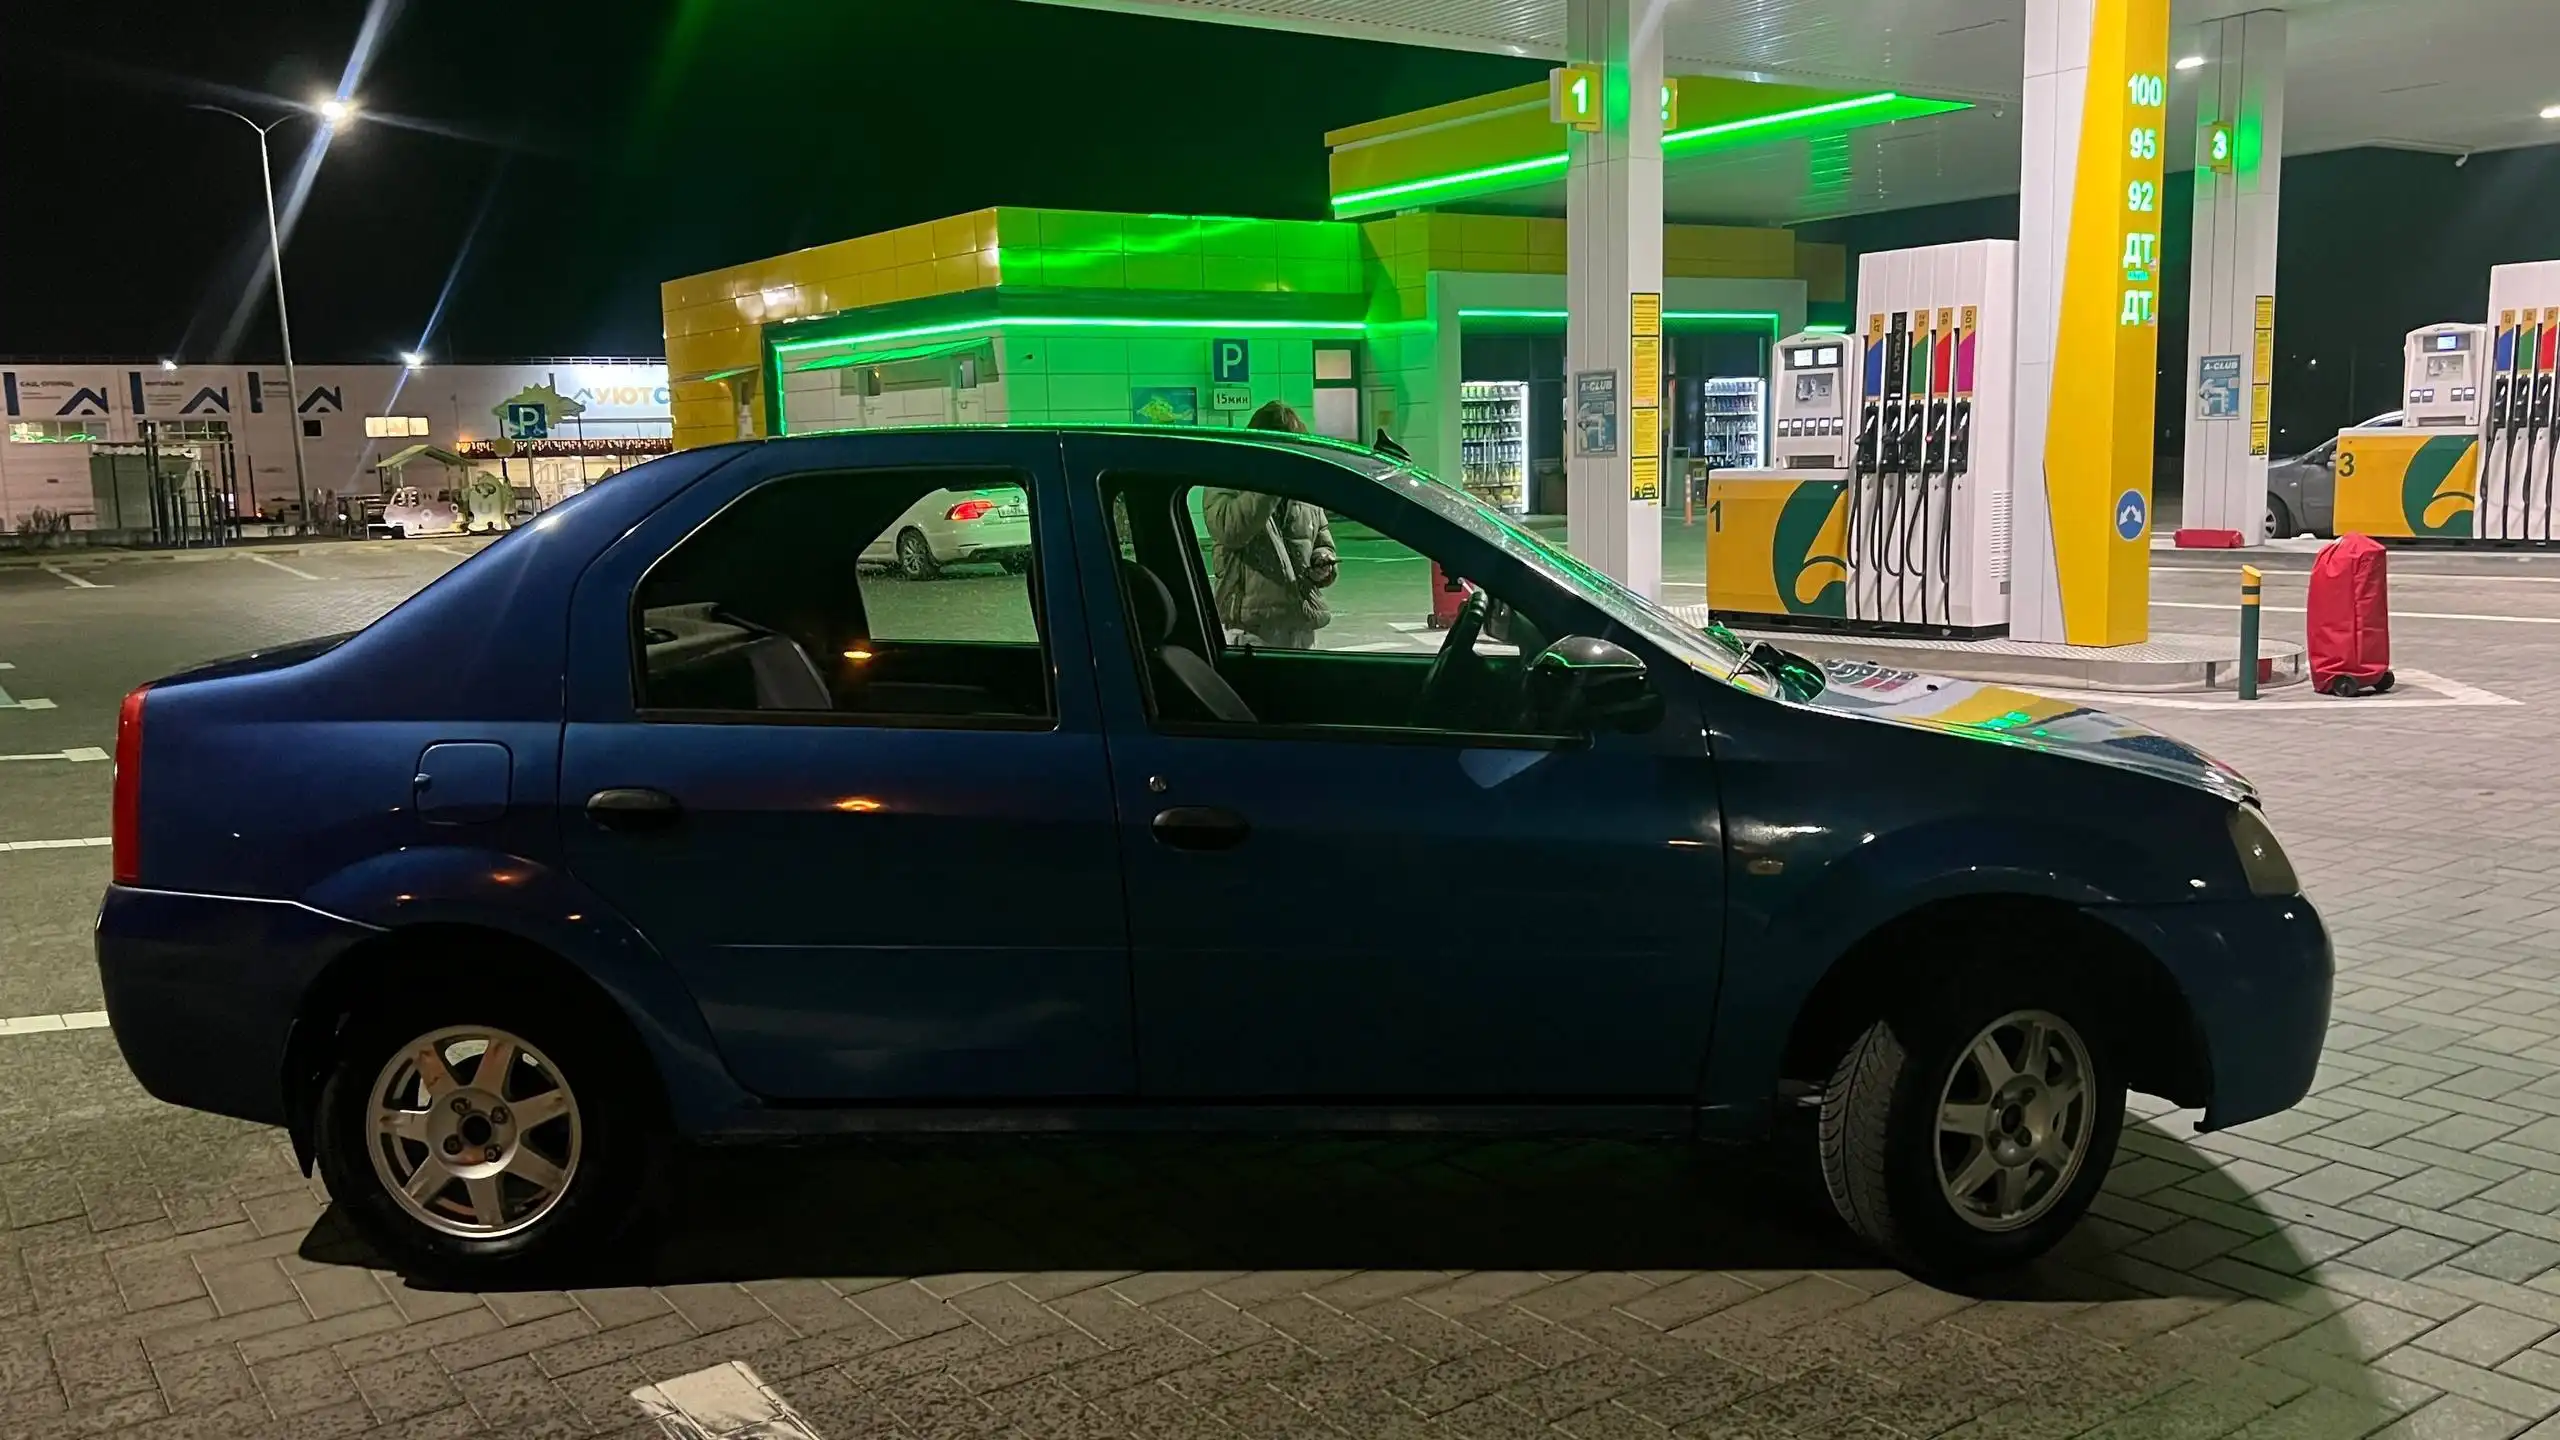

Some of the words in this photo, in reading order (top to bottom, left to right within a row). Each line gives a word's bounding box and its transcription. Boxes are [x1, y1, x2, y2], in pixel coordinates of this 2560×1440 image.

[1571, 77, 1587, 114] 1
[2127, 73, 2163, 107] 100
[2129, 127, 2156, 160] 95
[2212, 130, 2227, 160] 3
[2128, 179, 2154, 212] 92
[2123, 232, 2156, 269] ДТ
[1965, 309, 1973, 329] 100
[2121, 289, 2153, 325] ДТ
[1222, 343, 1242, 378] P
[518, 407, 541, 436] P
[2338, 452, 2355, 477] 3
[1710, 500, 1721, 533] 1
